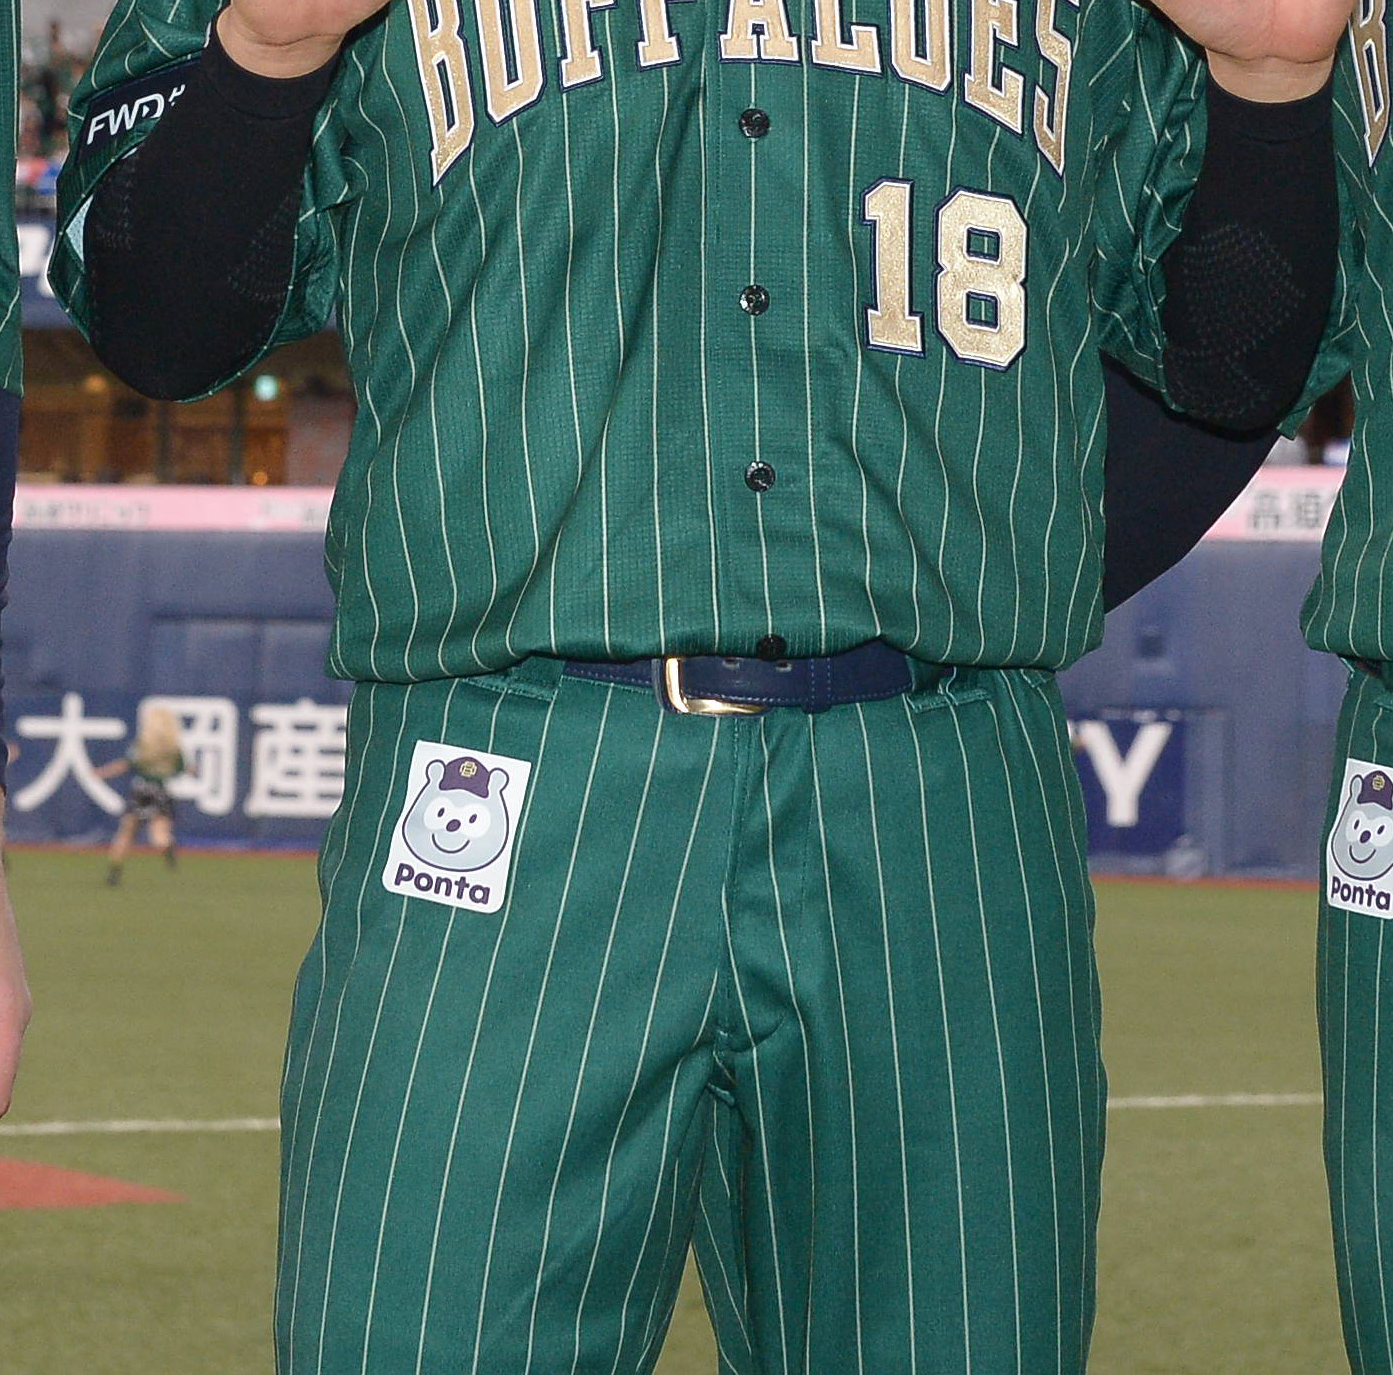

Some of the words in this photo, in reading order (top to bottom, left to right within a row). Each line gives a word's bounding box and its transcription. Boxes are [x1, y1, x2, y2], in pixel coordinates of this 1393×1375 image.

[862, 178, 1027, 371] 18
[1068, 719, 1174, 827] Y
[394, 862, 491, 907] Ponta
[1330, 874, 1391, 912] Ponta
